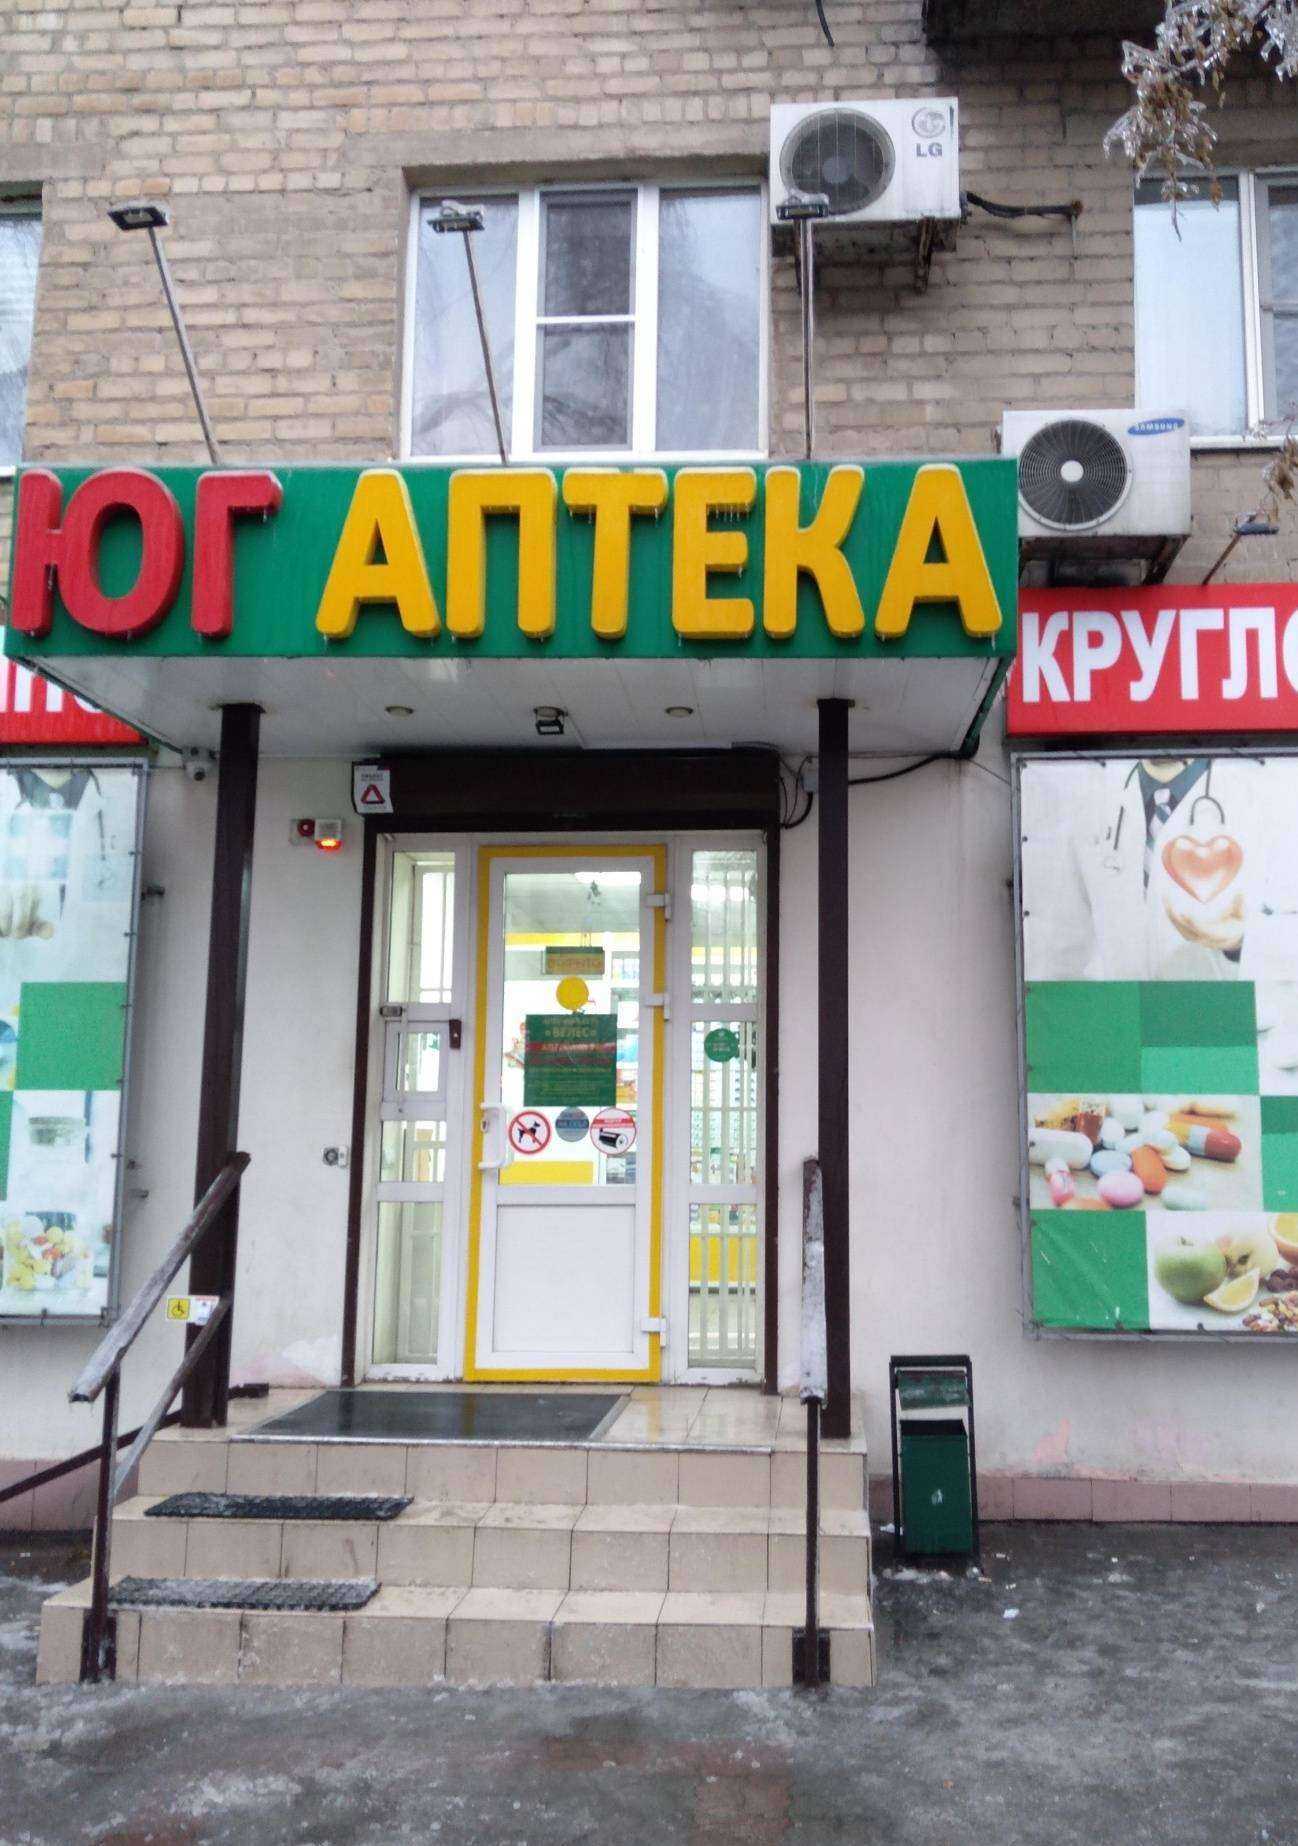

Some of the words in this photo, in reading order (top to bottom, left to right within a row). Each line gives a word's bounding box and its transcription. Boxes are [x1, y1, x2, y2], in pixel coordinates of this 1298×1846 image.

[916, 142, 943, 158] LG
[1135, 422, 1179, 433] SAMSUNG
[11, 467, 283, 638] ЮГ
[315, 464, 1003, 640] АПТЕКА
